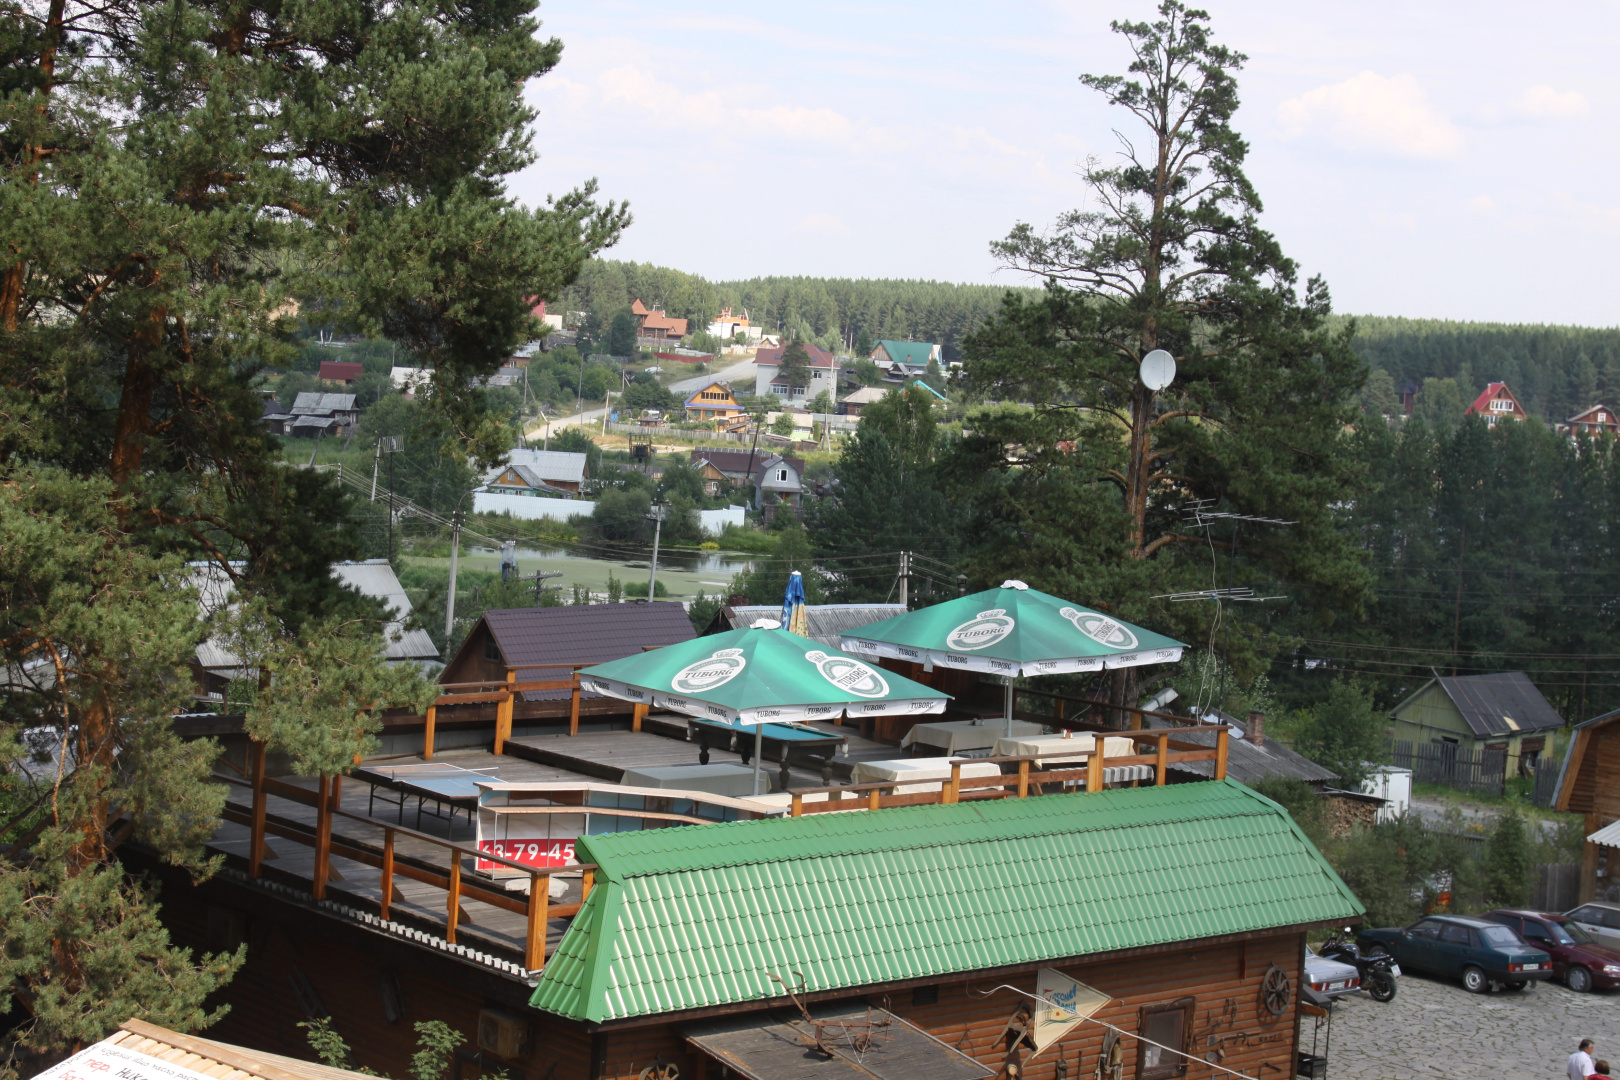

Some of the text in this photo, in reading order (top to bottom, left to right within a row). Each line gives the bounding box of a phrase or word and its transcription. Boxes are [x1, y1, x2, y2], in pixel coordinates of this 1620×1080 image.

[957, 626, 1006, 638] TUBORG
[1093, 621, 1116, 641] TUBORG
[858, 641, 877, 650] TUBORG
[898, 648, 919, 657] TUBORG
[947, 655, 968, 664] TUBORG
[990, 661, 1012, 670] TUBORG
[684, 668, 735, 678] TUBORG
[836, 667, 868, 686] TUBORG
[627, 688, 645, 699] TUBORG
[707, 705, 728, 717] TUBORG
[757, 710, 781, 718] TUBORG
[480, 843, 575, 861] 63-79-45
